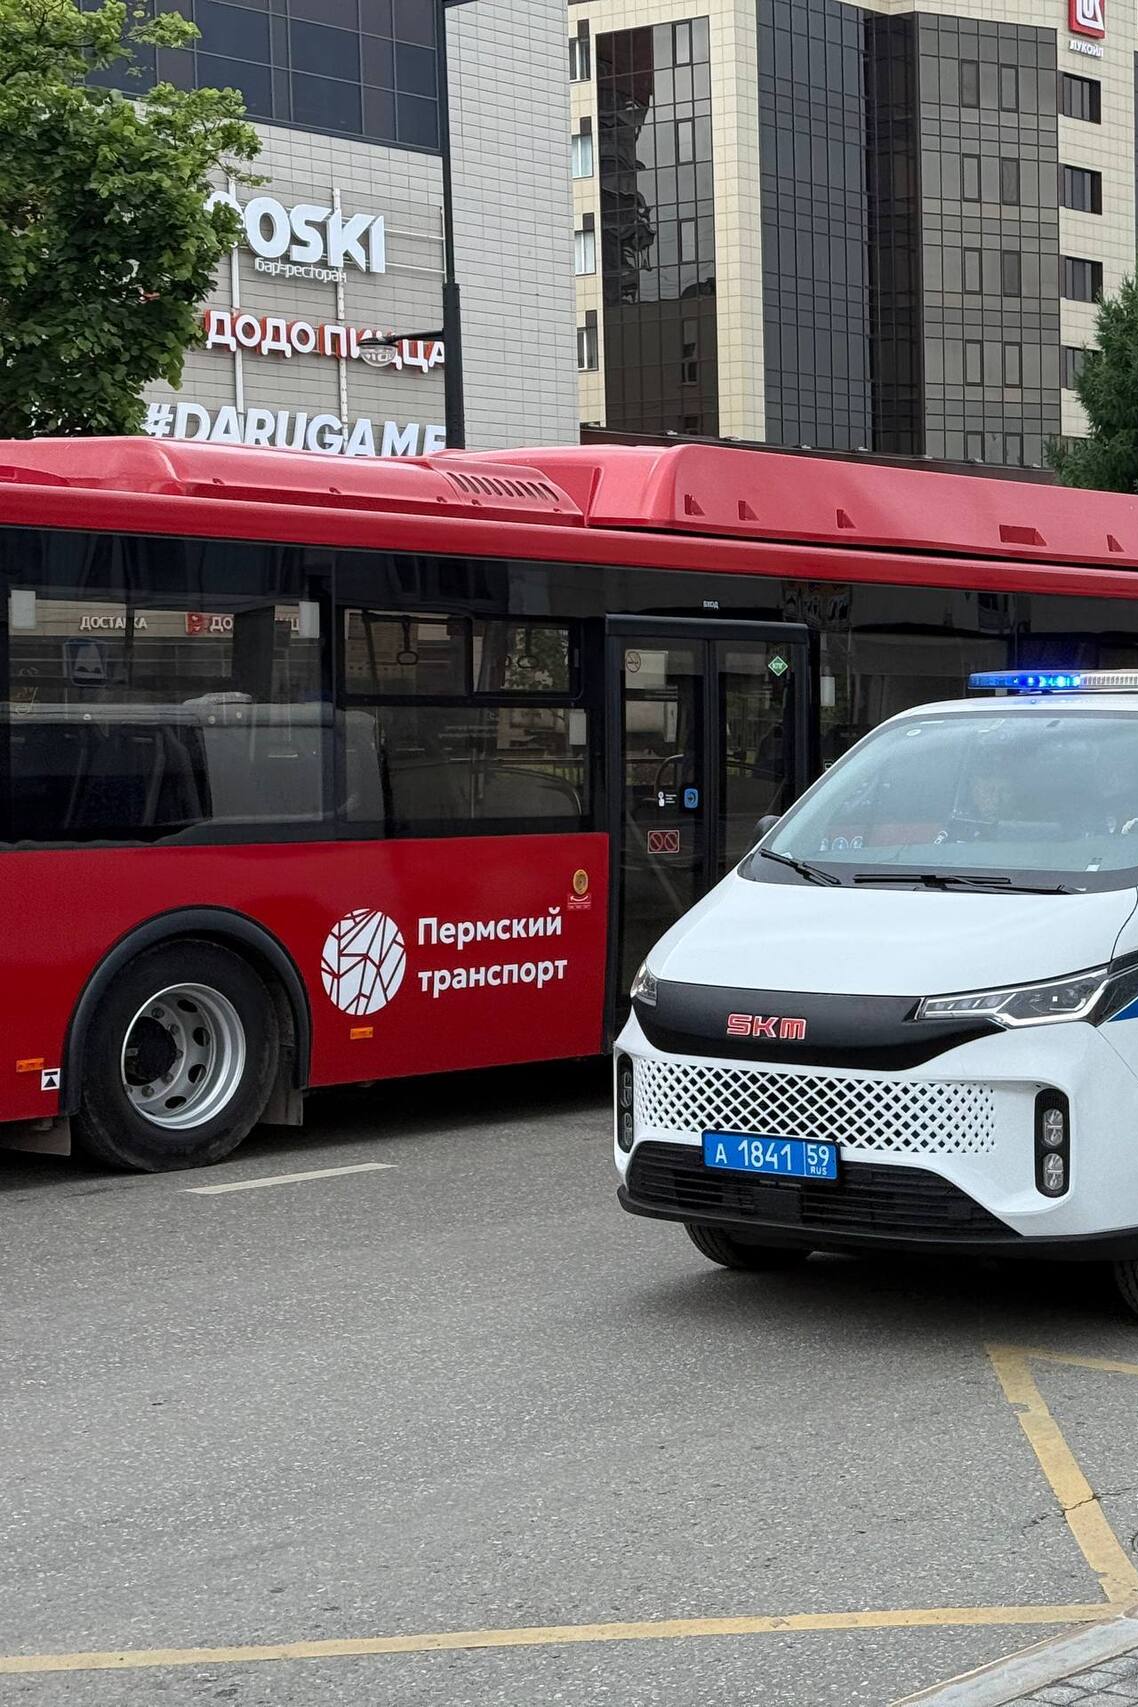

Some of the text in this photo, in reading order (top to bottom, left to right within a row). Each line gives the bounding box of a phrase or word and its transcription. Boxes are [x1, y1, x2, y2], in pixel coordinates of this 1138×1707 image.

[204, 191, 386, 274] OSKI
[254, 257, 347, 284] бар-ресторан
[205, 309, 316, 358] ДОДО
[79, 613, 148, 631] ДОСТАКА
[418, 906, 562, 950] Пермский
[418, 959, 568, 998] транспорт
[726, 1013, 807, 1040] SKM
[738, 1139, 792, 1171] 1841
[807, 1144, 830, 1167] 59
[810, 1166, 827, 1176] RUS
